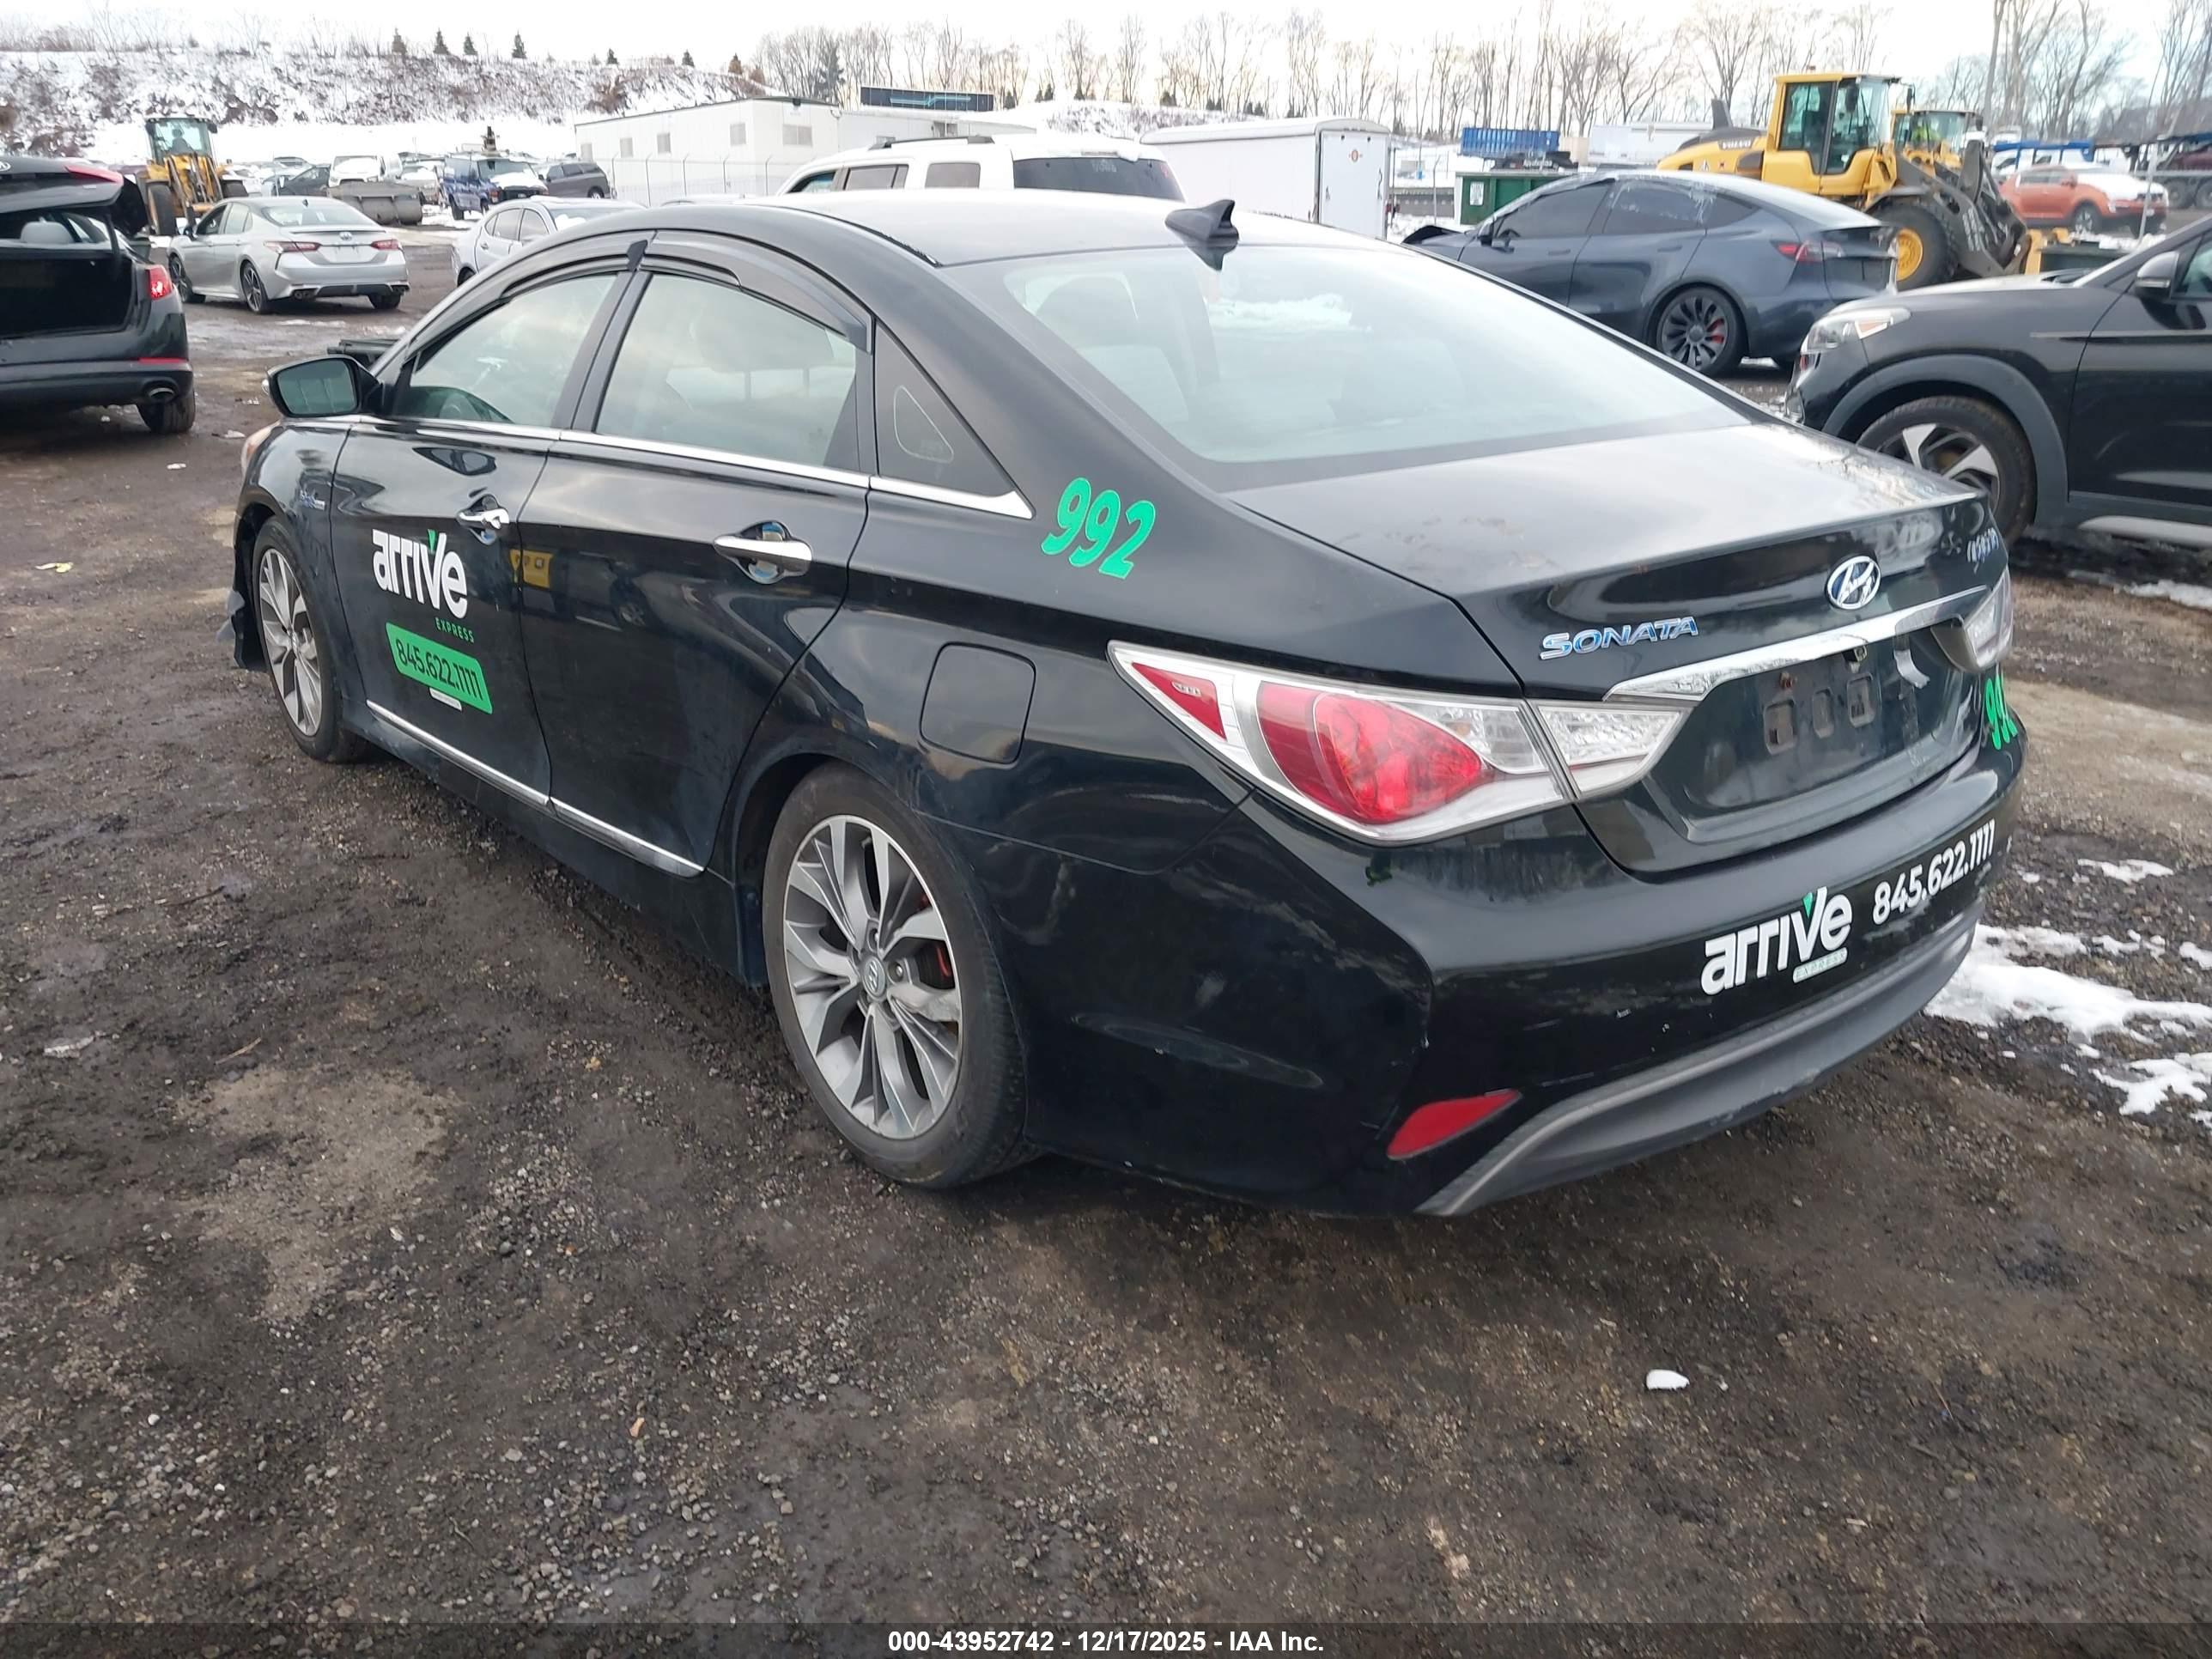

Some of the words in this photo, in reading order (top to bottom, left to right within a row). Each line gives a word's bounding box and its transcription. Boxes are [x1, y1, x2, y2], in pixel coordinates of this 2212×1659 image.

[1041, 477, 1156, 580] 992
[434, 617, 475, 644] EXPRESS
[1539, 616, 1698, 660] SONATA
[395, 637, 484, 702] 845.622.1111
[1871, 817, 1996, 926] 845.622.1111
